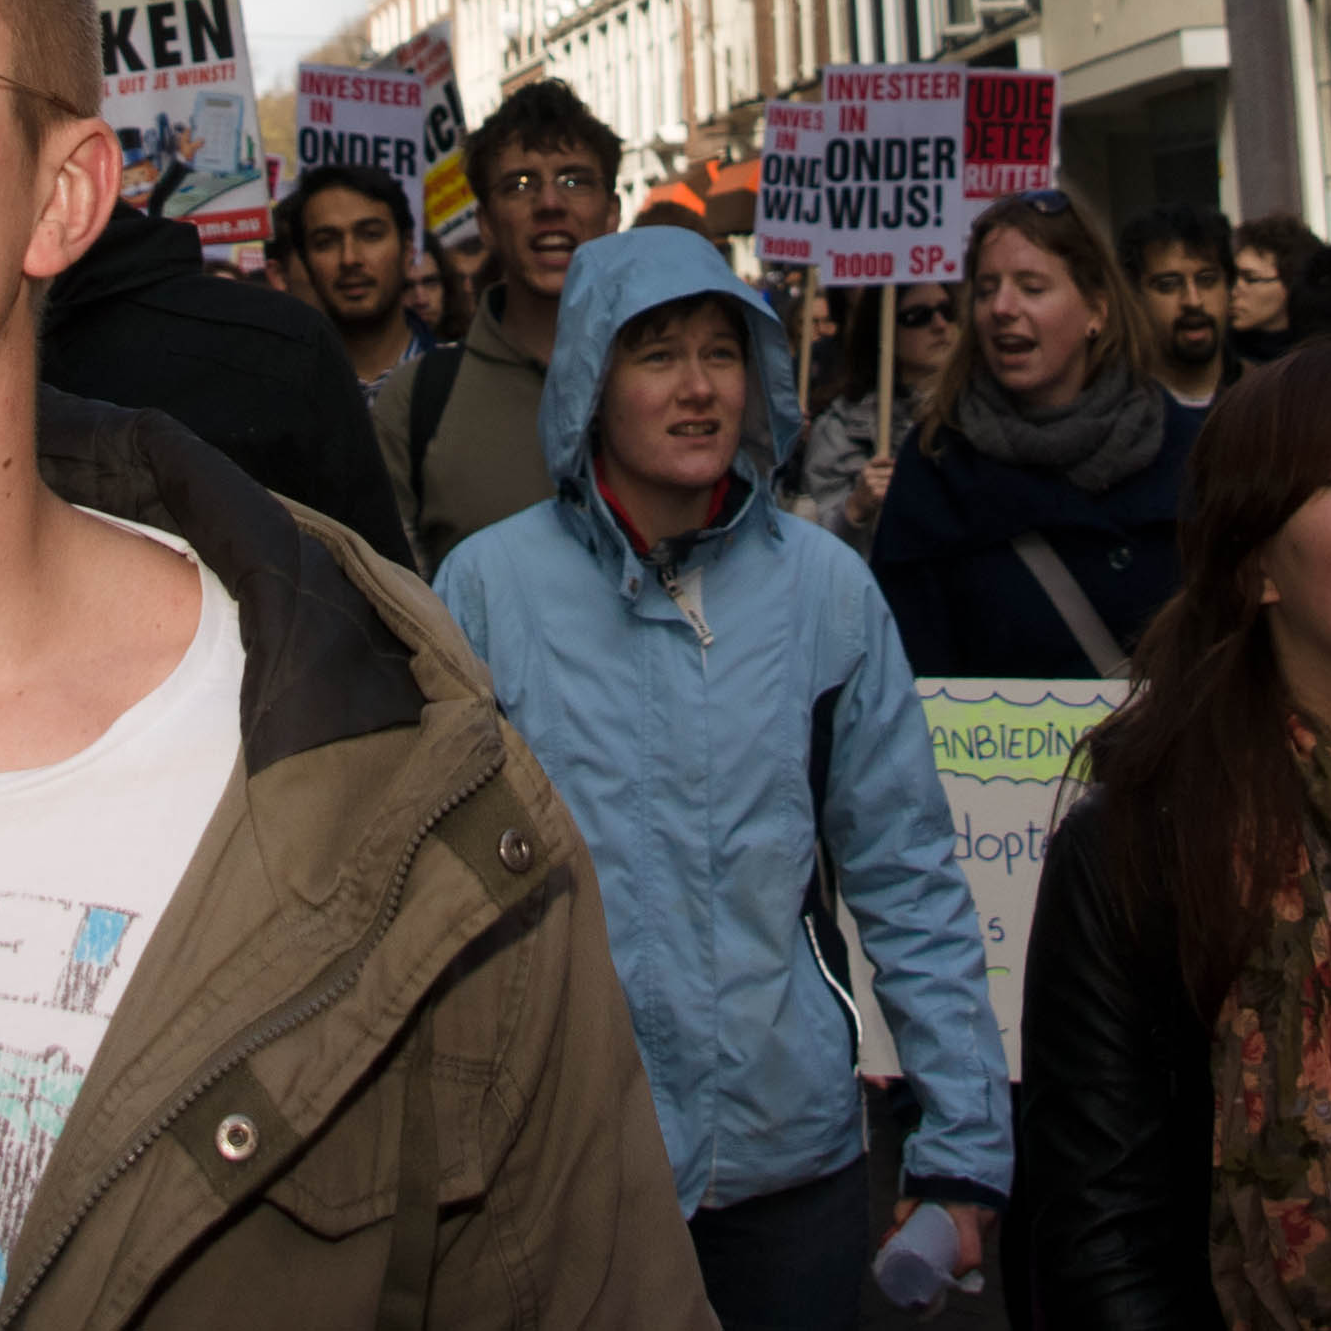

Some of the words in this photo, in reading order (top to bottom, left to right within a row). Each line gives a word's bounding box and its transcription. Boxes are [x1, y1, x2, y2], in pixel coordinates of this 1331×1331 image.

[301, 71, 422, 107] INVESTEER
[827, 72, 961, 101] INVESTEER
[309, 99, 333, 125] IN
[839, 105, 866, 133] IN
[299, 126, 417, 177] ONDER
[775, 131, 797, 152] IN
[825, 136, 957, 182] ONDER
[826, 185, 944, 230] WIJS!
[833, 252, 894, 278] ROOD
[909, 245, 945, 276] SP
